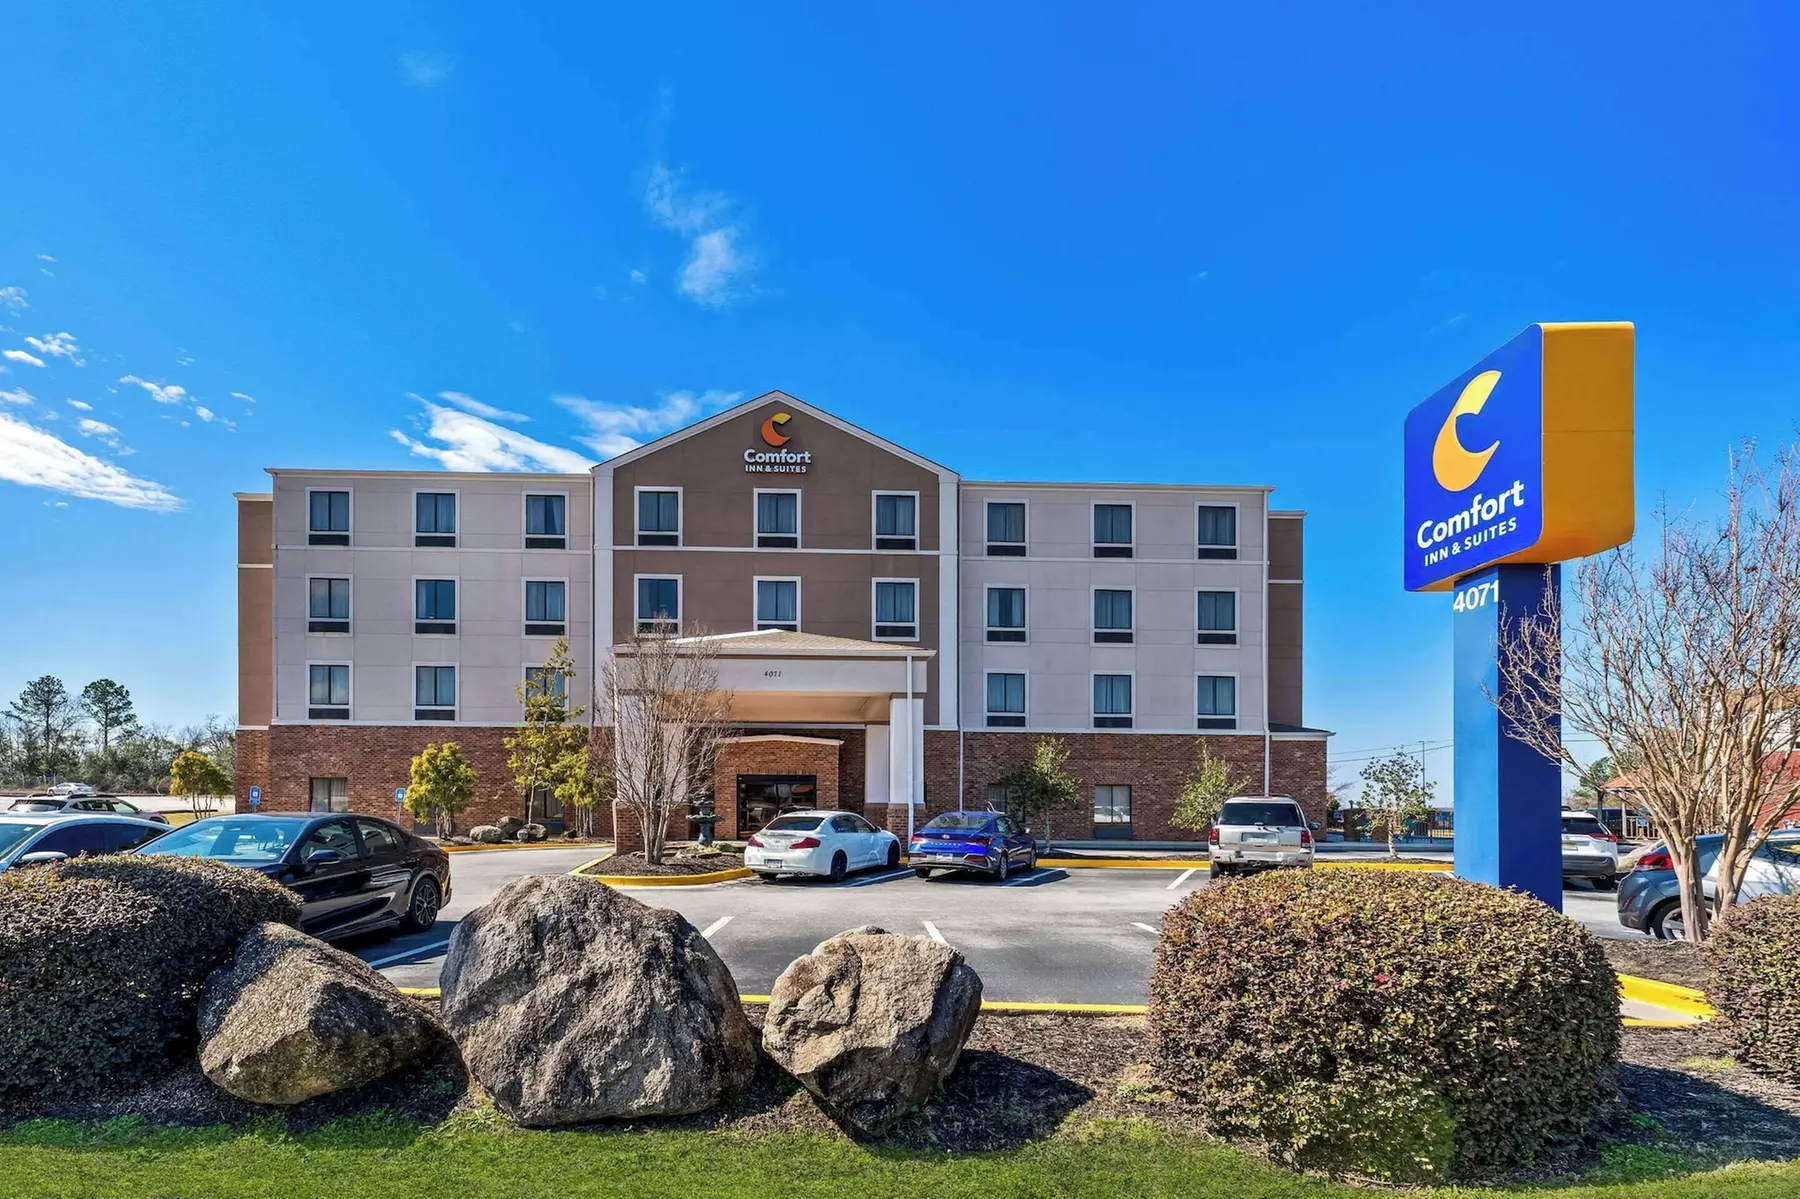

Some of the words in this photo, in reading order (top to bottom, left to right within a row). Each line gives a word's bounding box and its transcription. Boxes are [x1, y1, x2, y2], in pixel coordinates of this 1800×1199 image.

[743, 448, 811, 463] Comfort
[745, 464, 763, 472] INN
[765, 464, 772, 472] &
[773, 465, 807, 473] SUITES
[1416, 480, 1525, 549] Comfort
[1424, 549, 1449, 567] INN
[1451, 541, 1462, 556] &
[1464, 516, 1518, 551] SUITES
[1453, 578, 1499, 613] 4071
